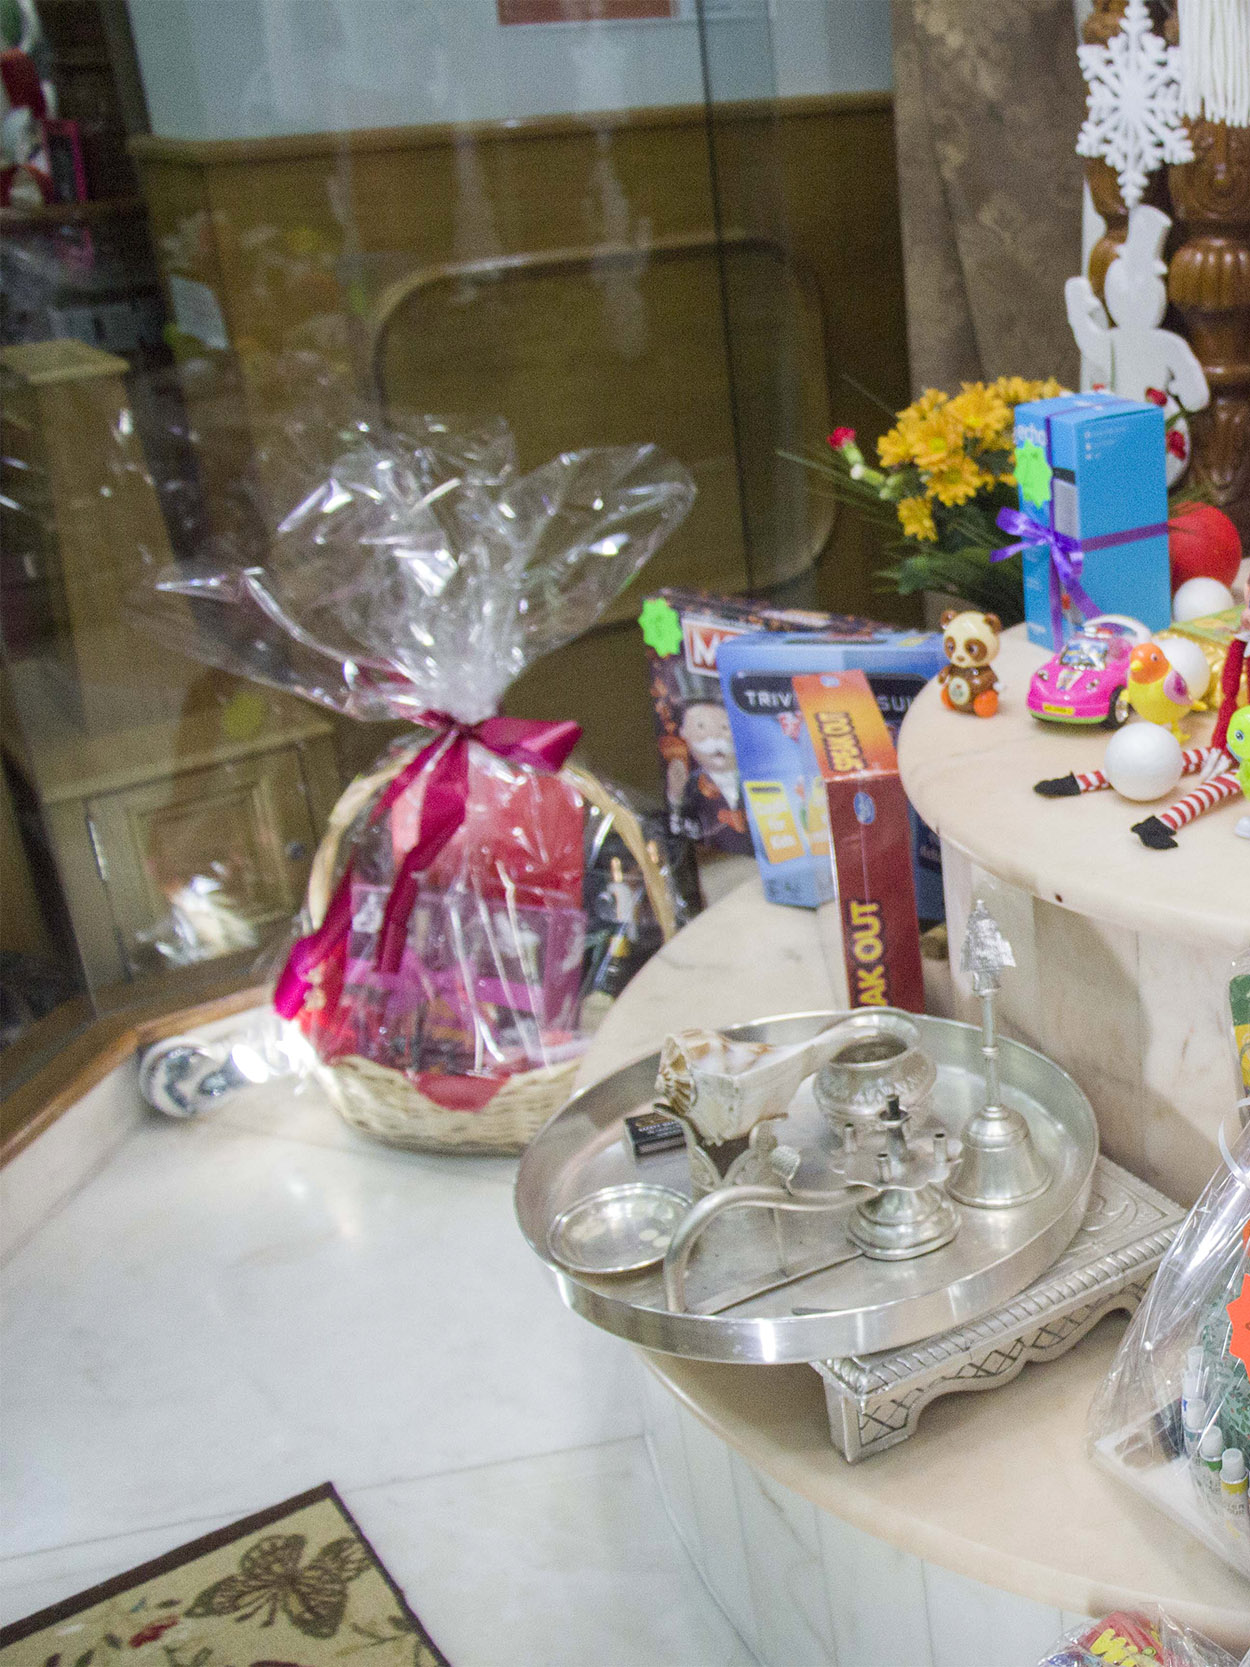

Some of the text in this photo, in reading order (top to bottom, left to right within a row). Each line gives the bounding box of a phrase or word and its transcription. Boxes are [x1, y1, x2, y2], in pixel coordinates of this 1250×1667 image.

[745, 689, 794, 708] TRIV
[849, 901, 888, 1007] AK OUT
